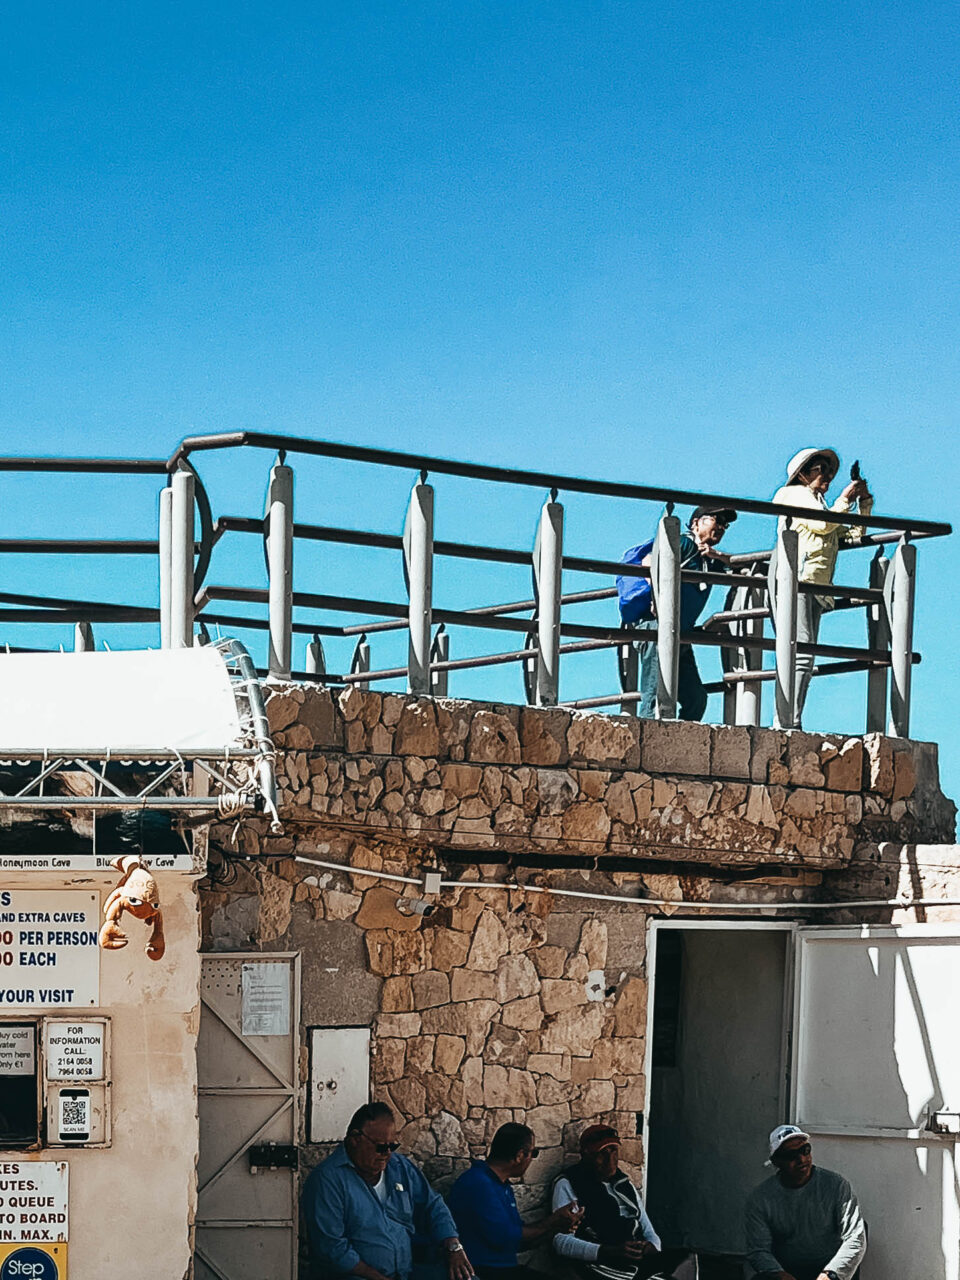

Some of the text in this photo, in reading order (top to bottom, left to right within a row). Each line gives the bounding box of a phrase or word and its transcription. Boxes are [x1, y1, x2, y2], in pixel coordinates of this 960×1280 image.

[52, 858, 71, 868] Cave
[156, 858, 175, 868] Cave
[18, 912, 51, 923] EXTRA
[53, 912, 86, 923] CAVES
[19, 931, 44, 945] PER
[47, 931, 98, 946] PERSON
[19, 952, 56, 966] EACH
[39, 989, 74, 1003] VISIT
[67, 1026, 83, 1034] FOR
[12, 1031, 28, 1040] cold
[49, 1037, 101, 1045] INFORMATION
[16, 1051, 31, 1059] here
[14, 1060, 24, 1068] €1
[8, 1197, 55, 1208] QUEUE
[20, 1214, 66, 1224] BOARD
[20, 1230, 54, 1241] MAX.
[8, 1259, 45, 1277] Step
